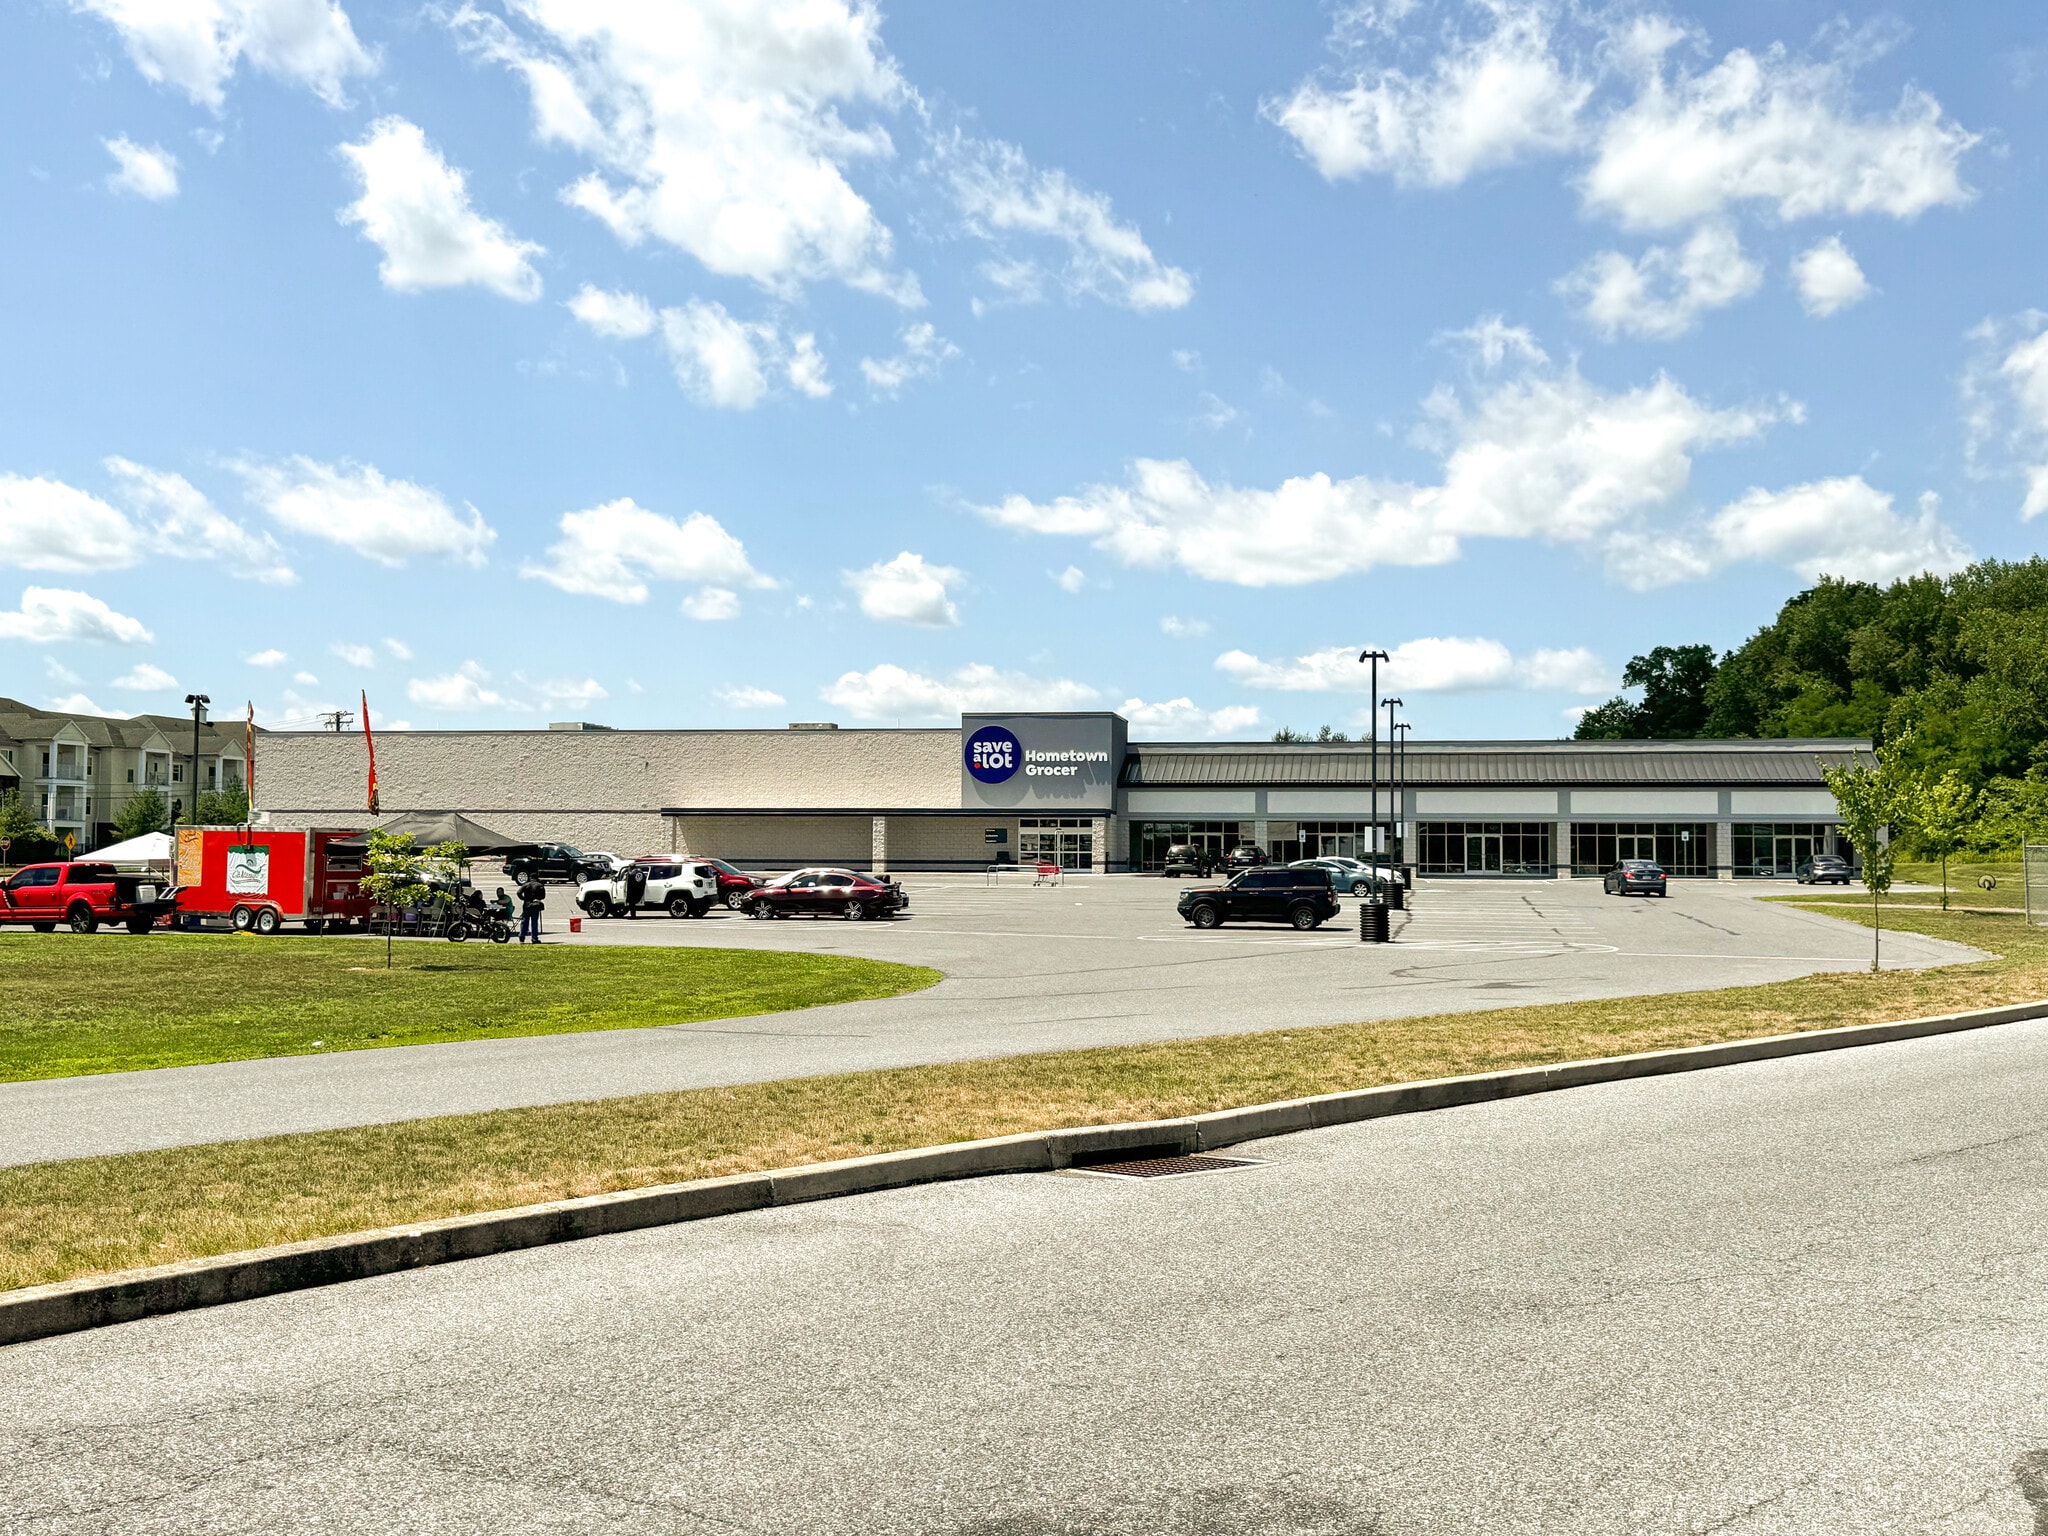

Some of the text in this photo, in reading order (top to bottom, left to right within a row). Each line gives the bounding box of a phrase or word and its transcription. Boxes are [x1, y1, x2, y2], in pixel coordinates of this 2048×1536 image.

[973, 741, 1012, 753] save
[973, 754, 981, 762] a
[1025, 750, 1108, 762] Hometown
[1025, 764, 1077, 776] Grocer
